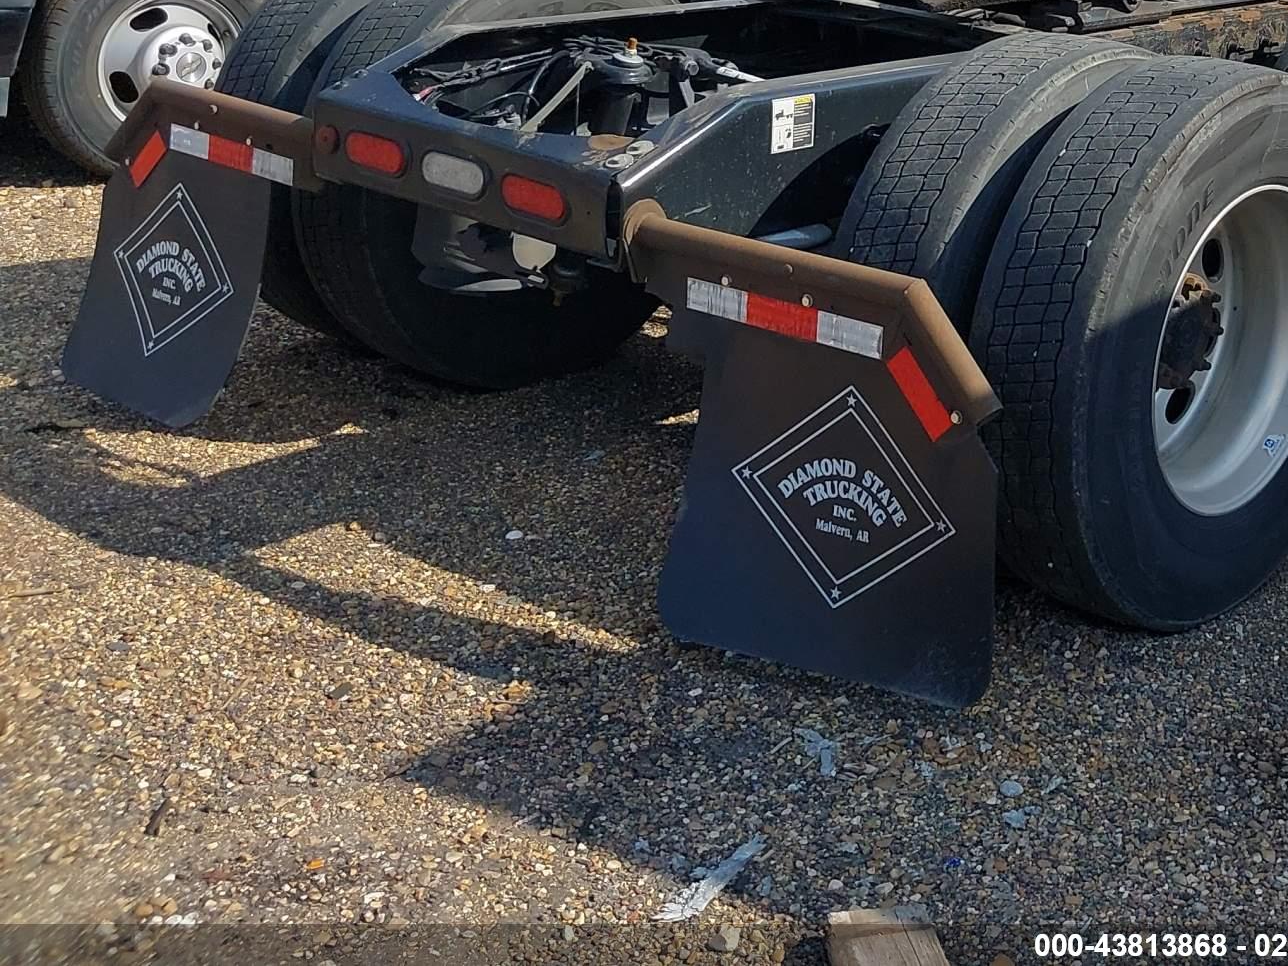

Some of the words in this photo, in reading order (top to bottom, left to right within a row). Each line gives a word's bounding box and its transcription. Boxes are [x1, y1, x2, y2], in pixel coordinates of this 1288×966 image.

[136, 241, 180, 273] DIAMOND
[182, 248, 205, 292] STATE
[149, 257, 193, 292] TRUCKING
[163, 277, 176, 290] INC.
[777, 458, 857, 499] DIAMOND
[861, 469, 909, 528] STATE
[802, 480, 887, 528] TRUCKING
[815, 517, 853, 542] Malvern,
[856, 529, 870, 543] AR
[832, 504, 857, 522] INC.
